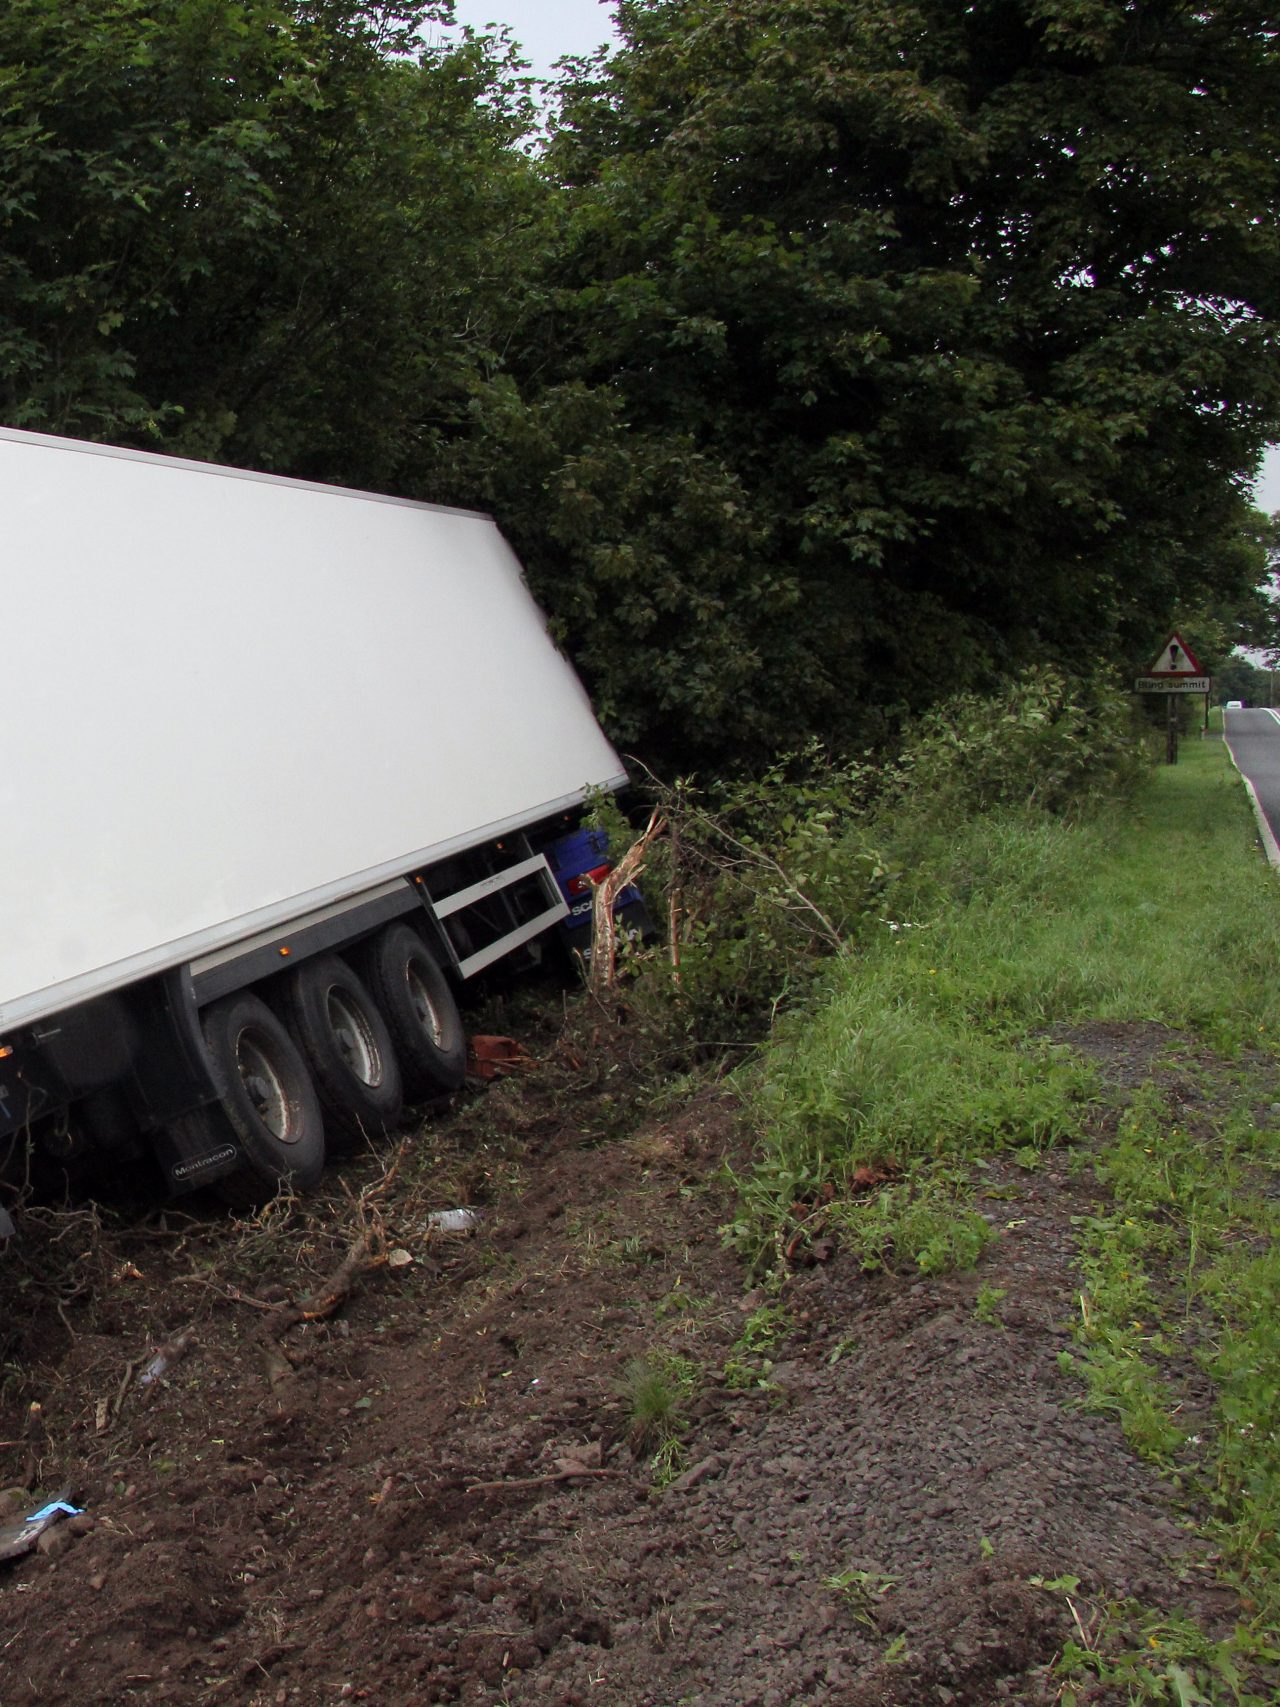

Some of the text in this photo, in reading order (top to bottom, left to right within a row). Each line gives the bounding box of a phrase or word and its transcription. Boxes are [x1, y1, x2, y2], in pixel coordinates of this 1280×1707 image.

[1138, 680, 1206, 689] Blind summit
[175, 1149, 234, 1176] Montracon
